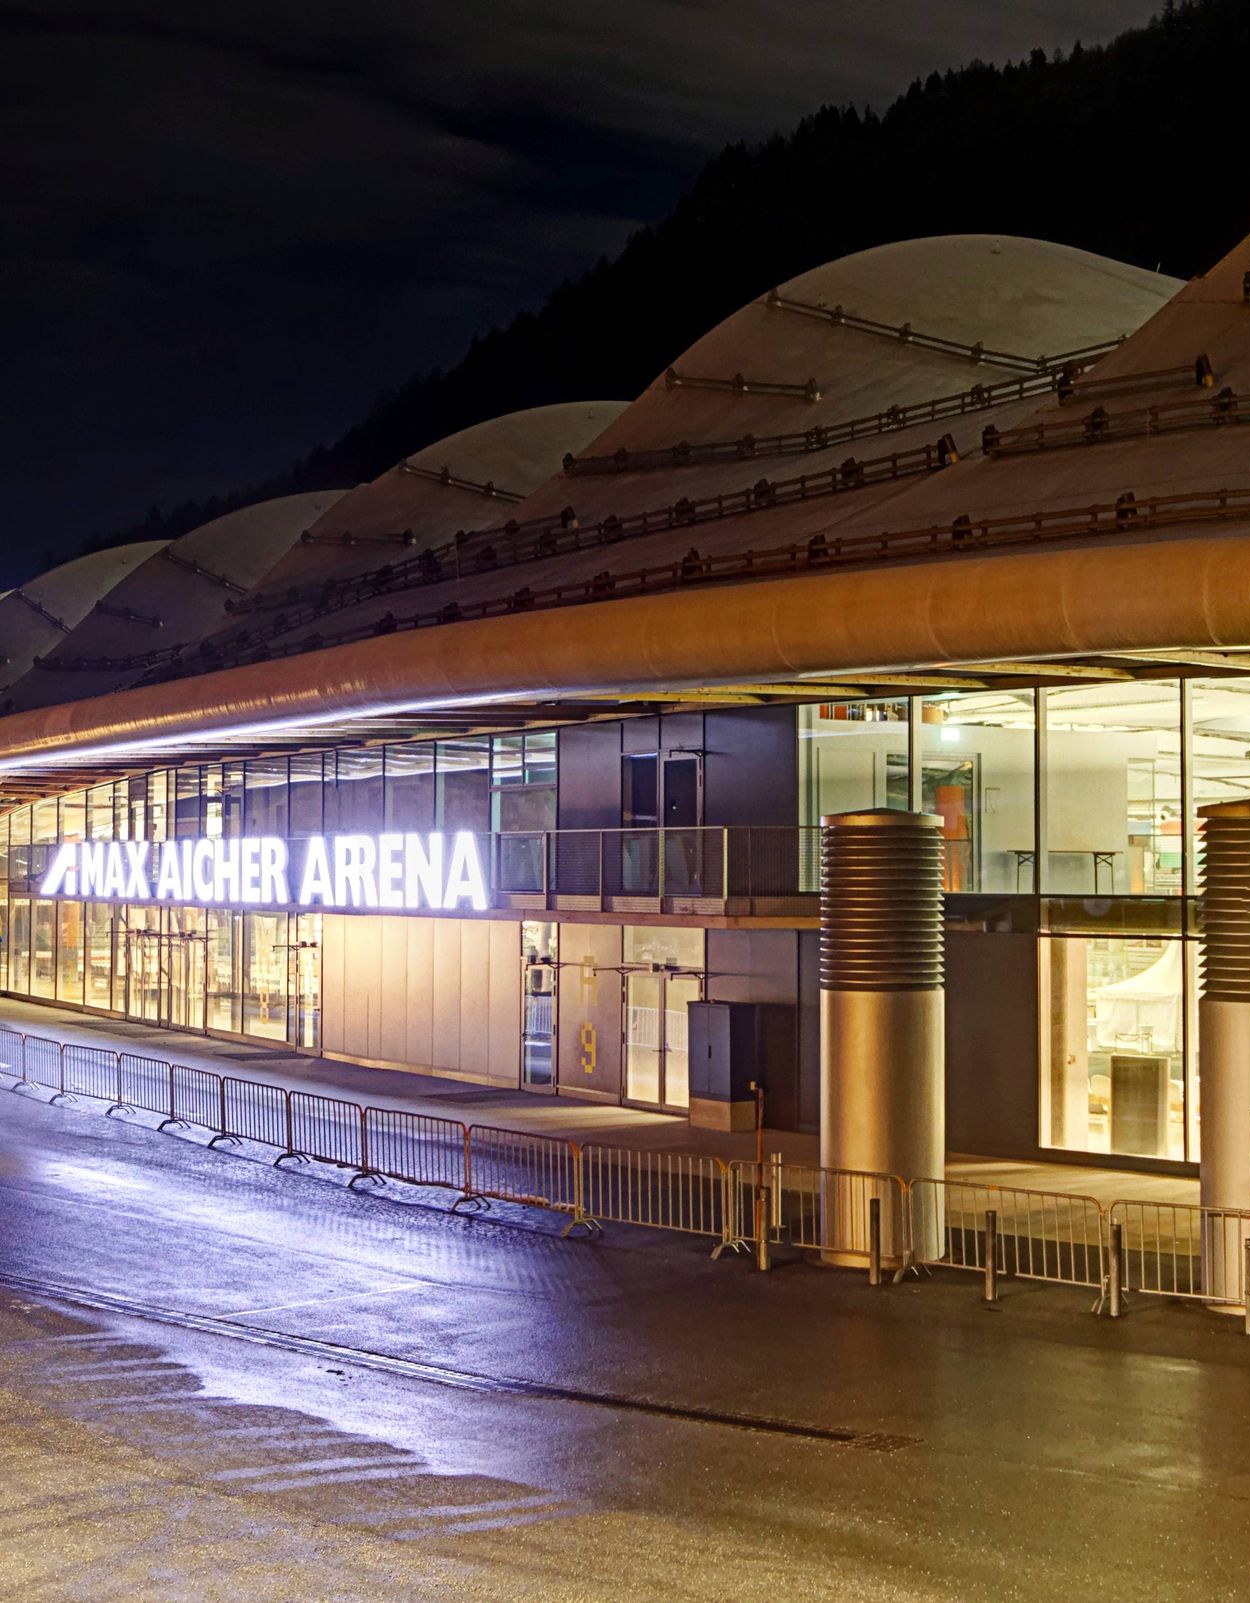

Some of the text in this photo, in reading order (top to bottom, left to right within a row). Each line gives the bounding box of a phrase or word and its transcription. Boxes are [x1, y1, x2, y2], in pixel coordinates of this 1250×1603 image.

[81, 841, 149, 898] MAX
[157, 837, 288, 904] AICHER
[581, 1023, 596, 1073] 9
